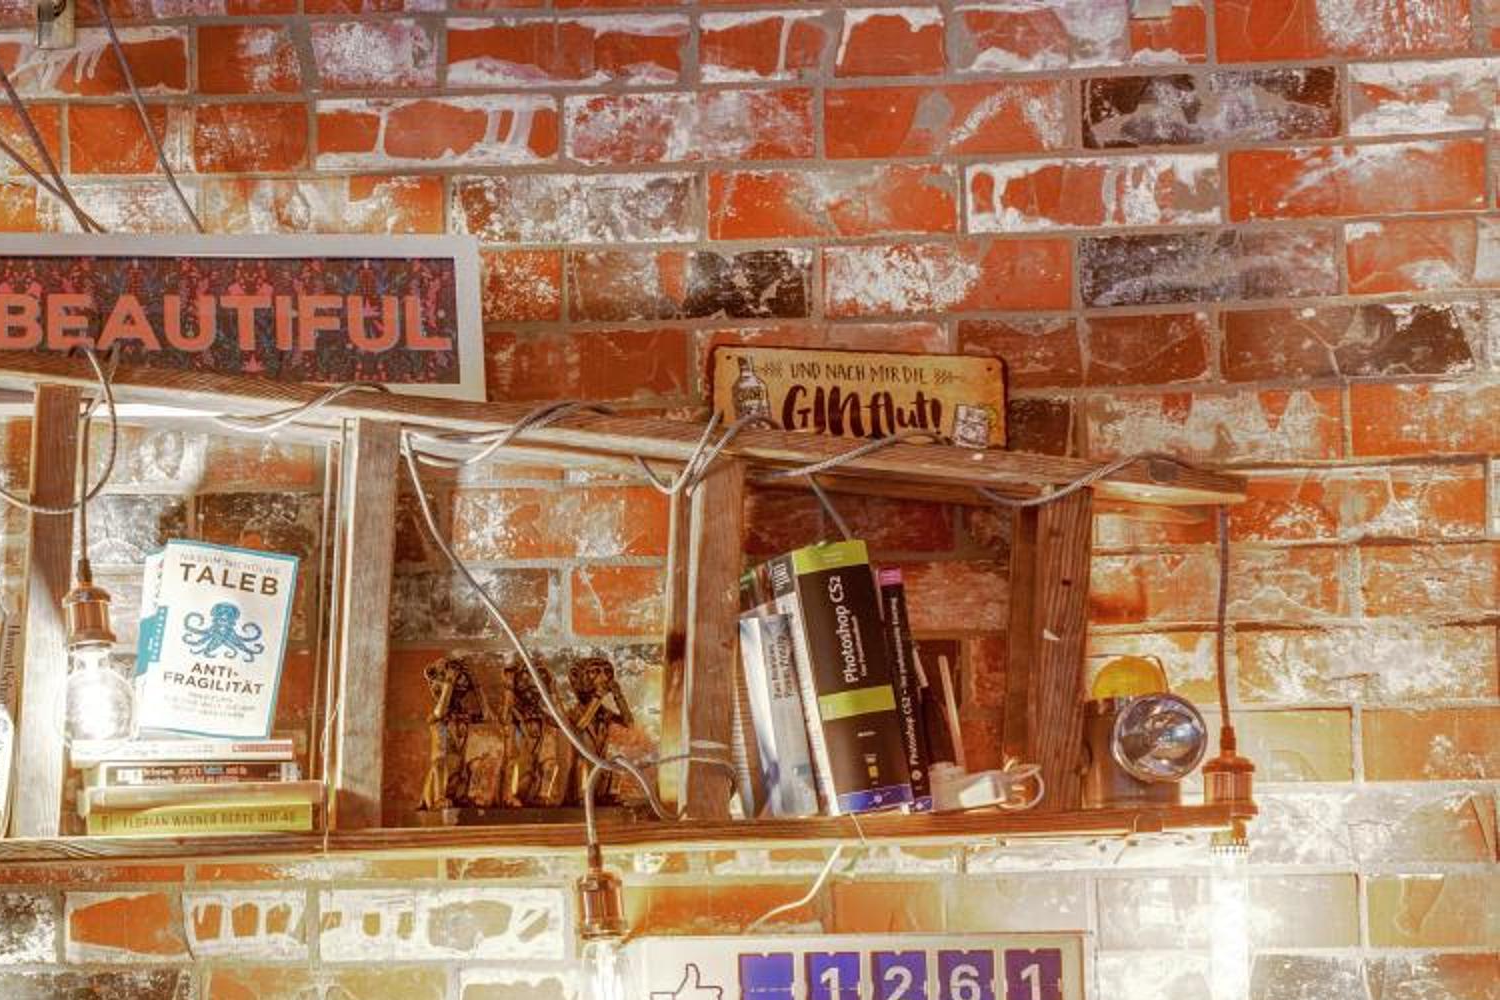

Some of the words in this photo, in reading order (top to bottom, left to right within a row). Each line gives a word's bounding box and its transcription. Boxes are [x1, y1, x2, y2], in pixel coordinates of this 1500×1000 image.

[791, 362, 820, 380] UND
[825, 363, 865, 382] NACH
[180, 563, 279, 596] TALEB
[828, 575, 844, 602] CS2
[836, 607, 860, 684] Photoshop
[163, 671, 265, 695] FRAGILITÄT
[191, 662, 239, 679] ANTI-
